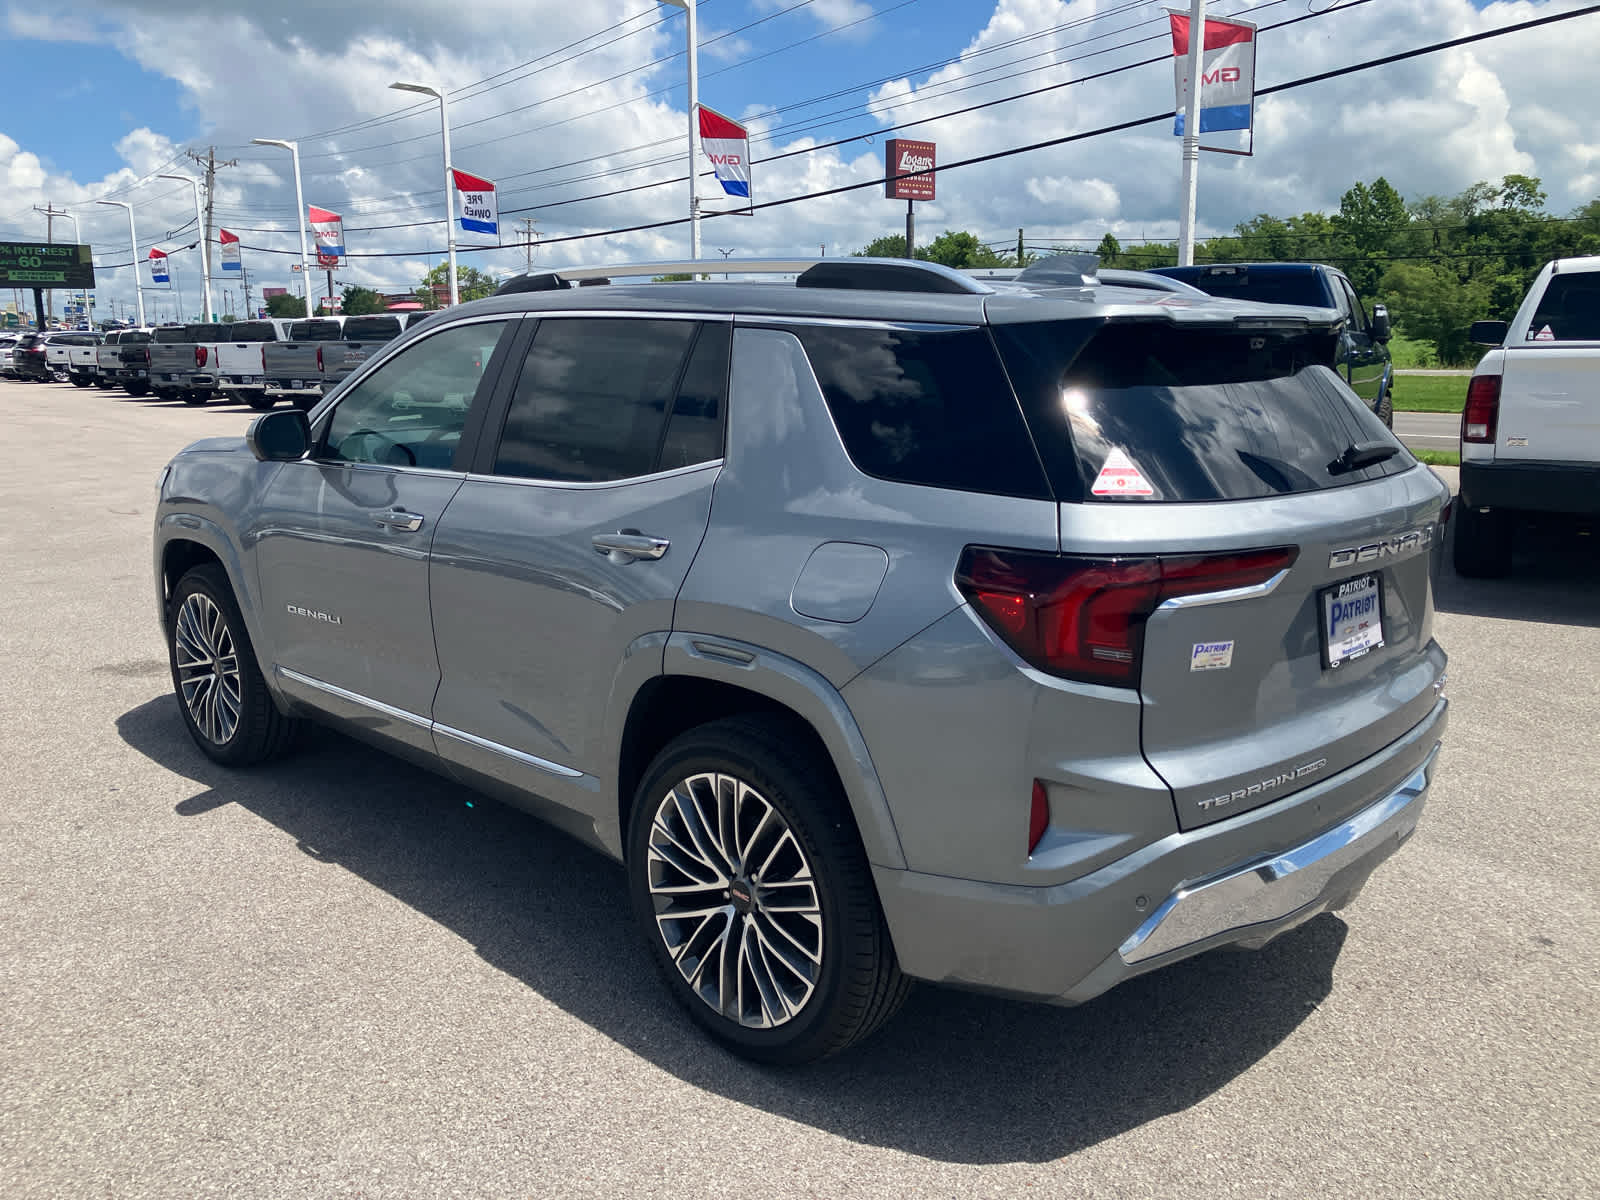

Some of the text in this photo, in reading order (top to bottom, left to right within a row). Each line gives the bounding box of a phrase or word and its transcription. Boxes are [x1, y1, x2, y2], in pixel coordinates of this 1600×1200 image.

[14, 246, 73, 256] INTEREST
[18, 256, 41, 268] 60
[1328, 527, 1433, 568] DENALI
[1339, 576, 1370, 597] PATRIOT
[287, 605, 341, 624] DENALI
[1330, 594, 1376, 637] PATRIOT
[1193, 643, 1233, 659] PATRIOT
[1198, 771, 1296, 810] TERRAIN
